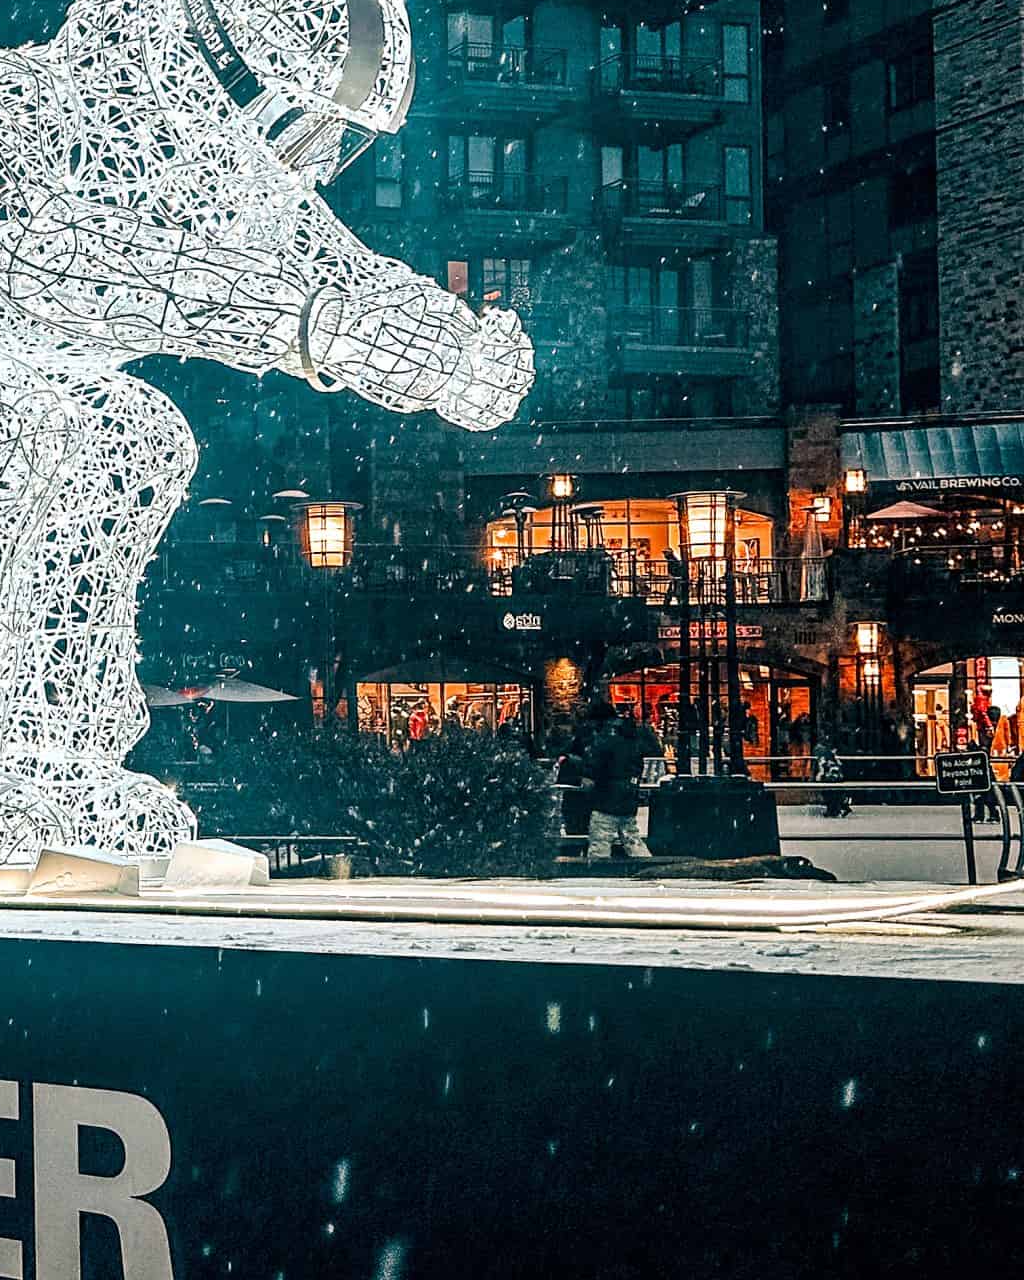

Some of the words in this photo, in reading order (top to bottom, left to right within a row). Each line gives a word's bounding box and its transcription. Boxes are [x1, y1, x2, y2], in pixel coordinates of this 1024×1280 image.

[912, 480, 939, 491] VAIL
[939, 477, 1001, 490] BREWING
[1001, 476, 1023, 488] CO.
[992, 613, 1024, 624] MON
[660, 627, 698, 637] TOMY
